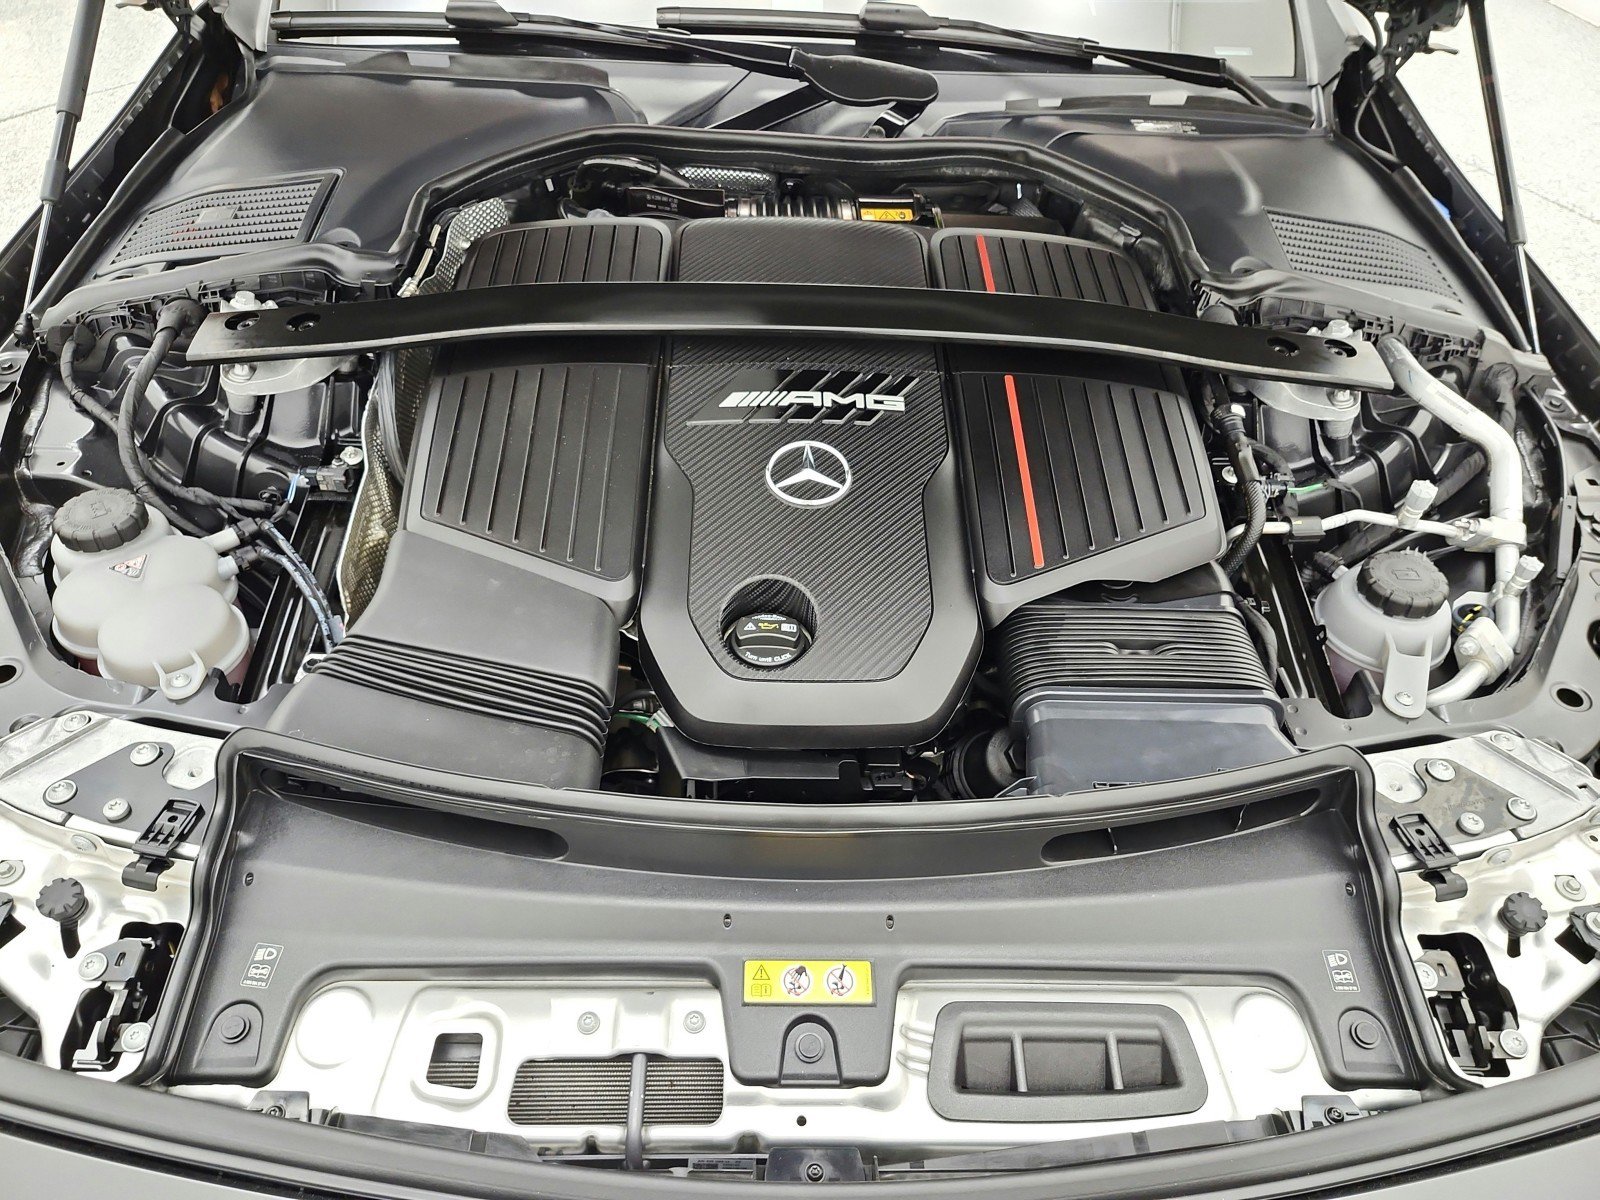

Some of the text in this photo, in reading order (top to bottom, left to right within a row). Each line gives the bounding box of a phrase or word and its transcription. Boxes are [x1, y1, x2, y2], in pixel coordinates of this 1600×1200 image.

[778, 391, 906, 412] AMG
[745, 651, 758, 660] Turn
[773, 652, 792, 662] CLICK
